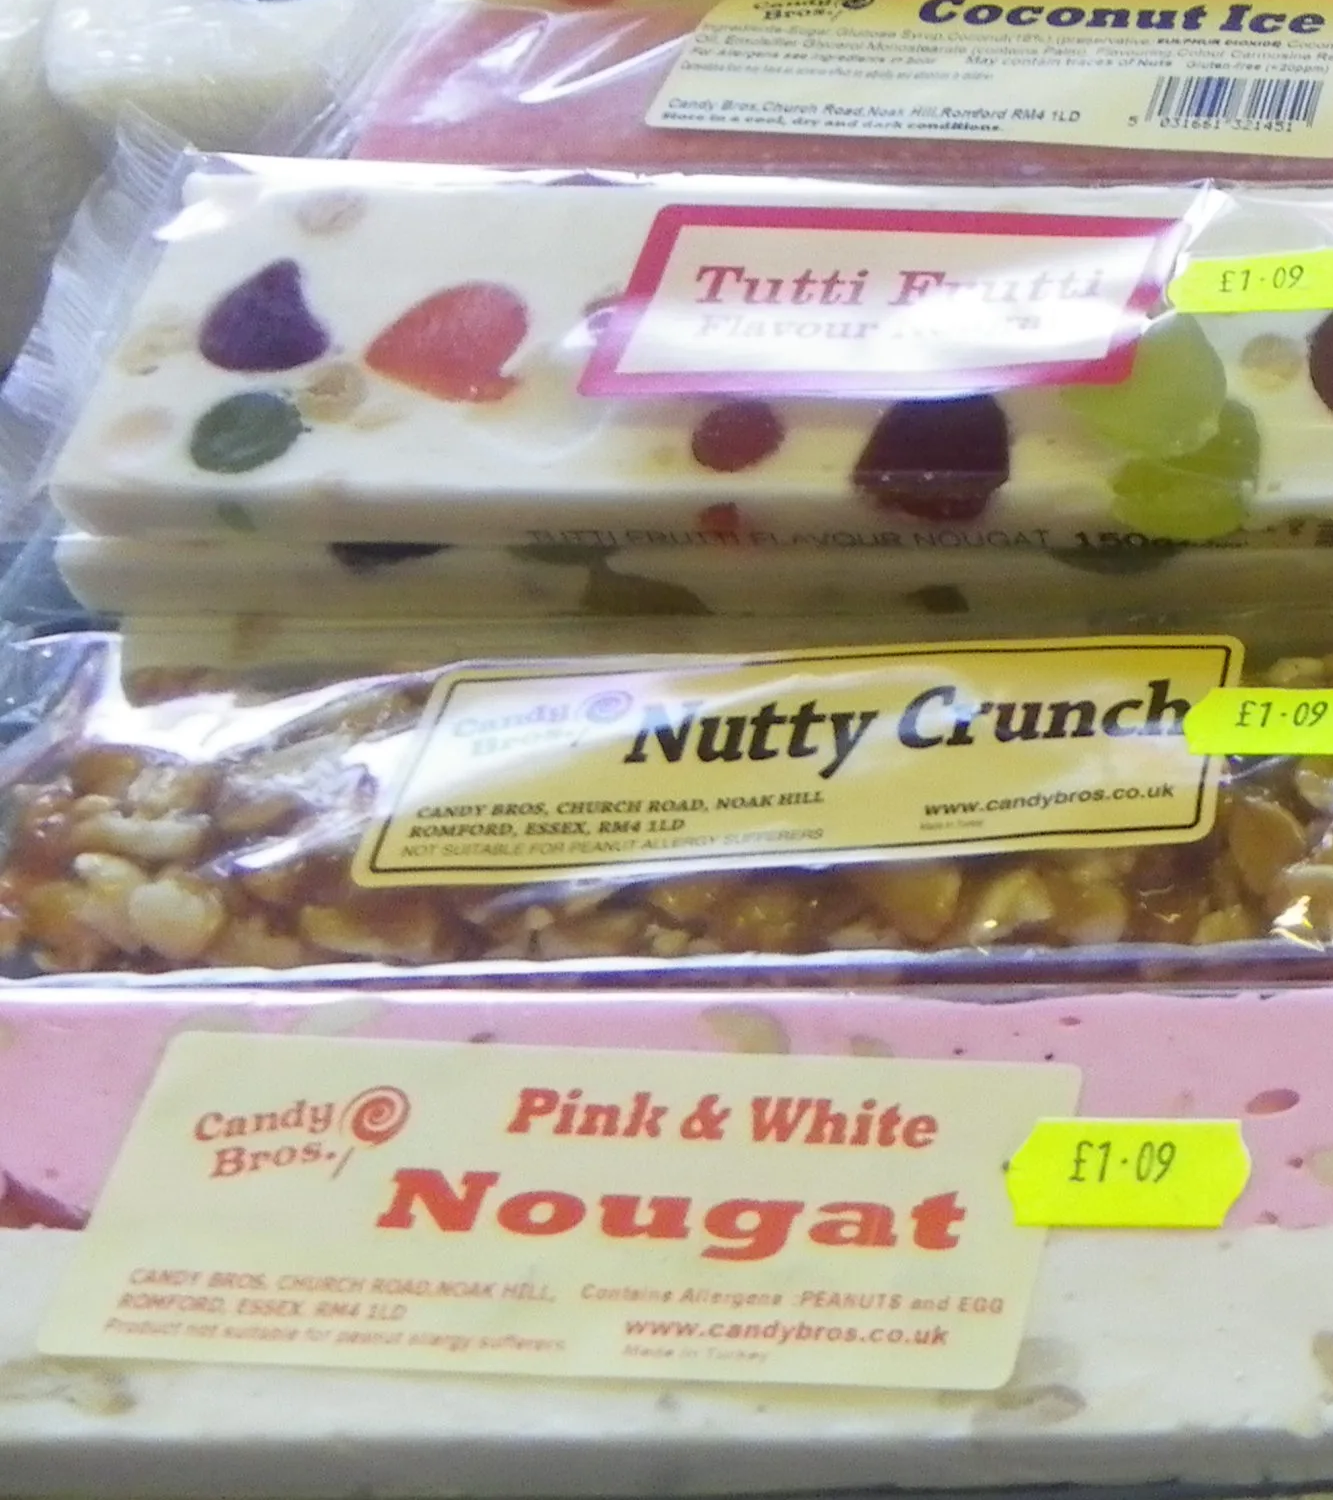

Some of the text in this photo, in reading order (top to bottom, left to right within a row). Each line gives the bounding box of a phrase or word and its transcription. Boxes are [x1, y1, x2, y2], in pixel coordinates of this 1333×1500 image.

[1219, 3, 1326, 34] Ice
[667, 97, 1082, 122] Candy RM4 1LD
[693, 265, 1103, 308] Tutti Frutti
[694, 312, 880, 342] Flavour
[617, 529, 1052, 548] FRUTTI FLAVOUR NOUGAT
[623, 677, 1190, 781] Nutty Crunch
[416, 804, 489, 819] CANDY
[555, 799, 643, 817] CHURCH
[714, 795, 774, 811] NOAK
[777, 791, 826, 808] HILL
[922, 782, 1176, 819] www.candybros.co.uk
[598, 819, 641, 835] RM4
[646, 817, 686, 834] 1LD
[193, 1099, 335, 1143] Candy
[504, 1086, 939, 1152] Pink & White
[208, 1141, 338, 1179] Bros.
[376, 1167, 971, 1264] Nougat
[578, 1282, 1006, 1316] Contains Allergens and EGG
[621, 1316, 951, 1348] www.candybros.co.uk
